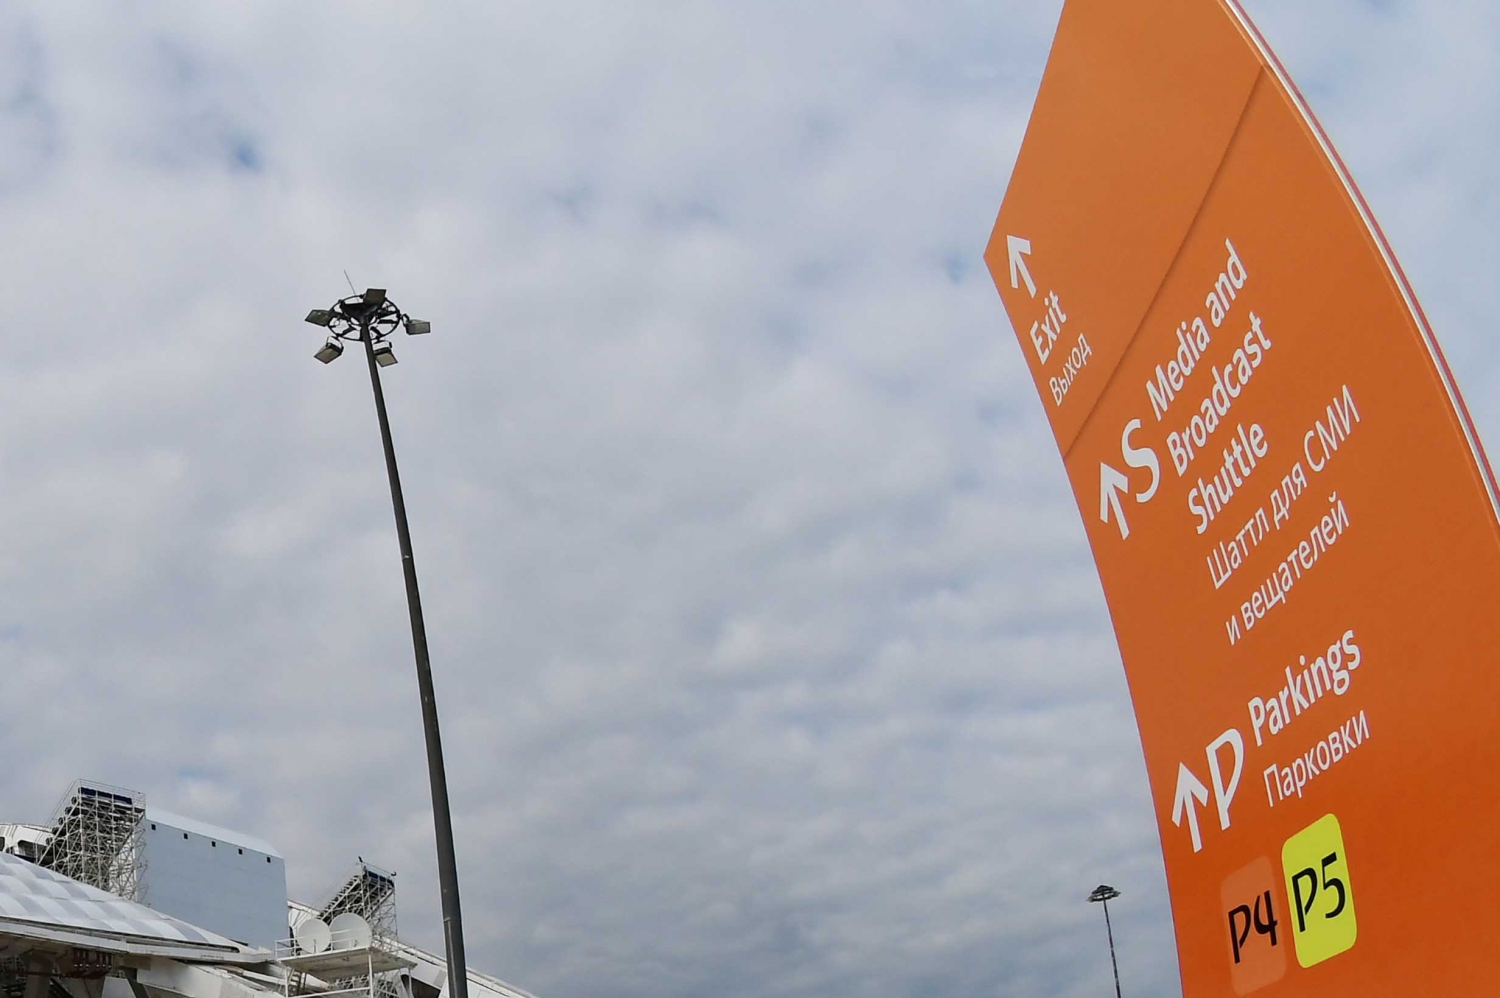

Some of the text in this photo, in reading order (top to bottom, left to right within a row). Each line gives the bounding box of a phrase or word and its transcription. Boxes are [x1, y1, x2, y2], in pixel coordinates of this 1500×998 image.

[1030, 288, 1067, 365] Exit
[1049, 332, 1092, 407] Выход
[1145, 238, 1248, 421] Media and
[1166, 311, 1272, 477] Broadcast
[1121, 418, 1161, 503] S
[1188, 423, 1268, 535] Shuttle
[1207, 384, 1360, 589] Шаттл для СМИ
[1225, 491, 1350, 646] и вещателей
[1247, 629, 1361, 747] Parkings
[1205, 728, 1244, 830] P
[1263, 710, 1370, 807] Парковки
[1228, 851, 1346, 964] P4 P5
